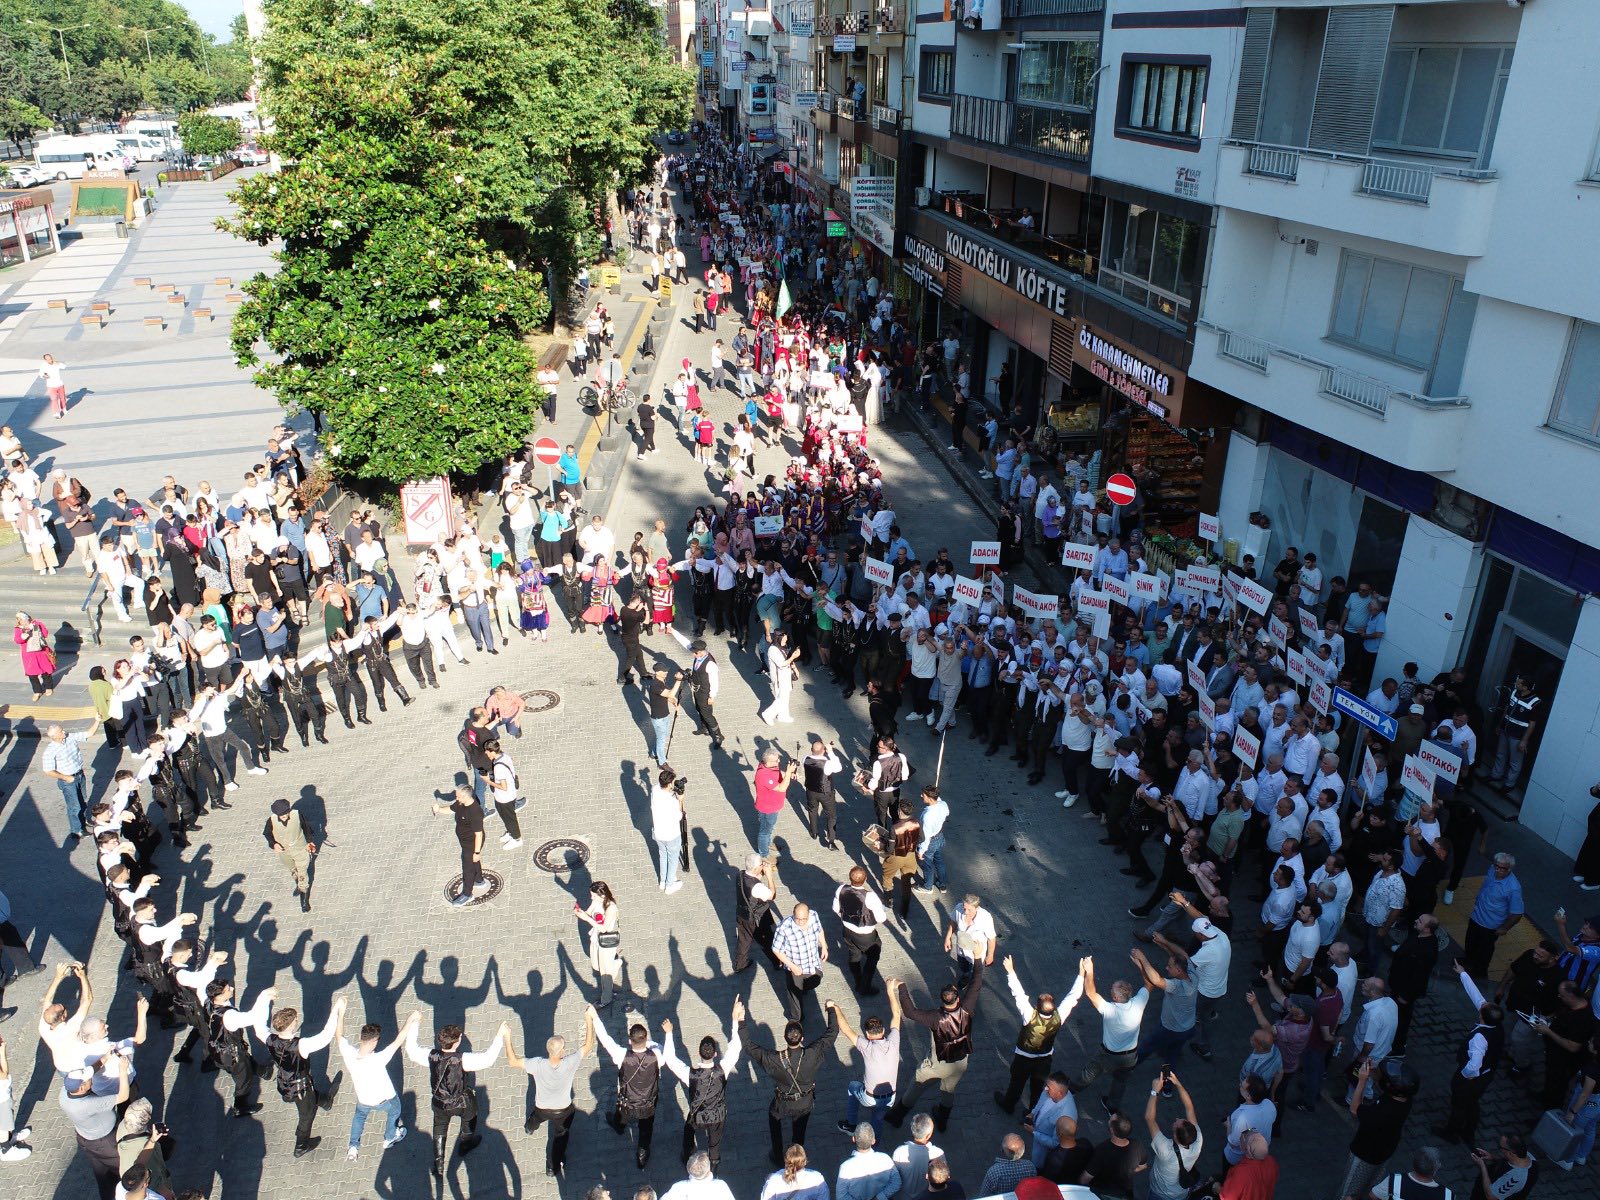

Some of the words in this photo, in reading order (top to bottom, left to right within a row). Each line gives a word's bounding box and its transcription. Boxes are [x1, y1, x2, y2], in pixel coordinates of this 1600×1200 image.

[904, 236, 944, 272] KOLOTOĞLU
[911, 262, 933, 292] KÖFTE
[946, 230, 1010, 284] KOLOTOĞLU
[1016, 267, 1067, 316] KÖFTE
[1079, 324, 1092, 350] ÖZ
[1091, 335, 1169, 396] KARAMEHMETLER
[972, 548, 999, 557] ADACIK
[867, 564, 890, 580] YENİKÖY
[1188, 573, 1217, 586] ÇINARLIK
[956, 583, 979, 599] ACISU
[1104, 582, 1127, 599] UĞURLU
[1136, 579, 1154, 592] ŞİNİK
[1242, 585, 1266, 605] SÖĞÜTLÜ
[1014, 592, 1038, 610] AKDAMAR
[1340, 696, 1355, 709] TEK
[1360, 708, 1376, 722] YÖN
[1420, 750, 1458, 775] ORTAKÖY
